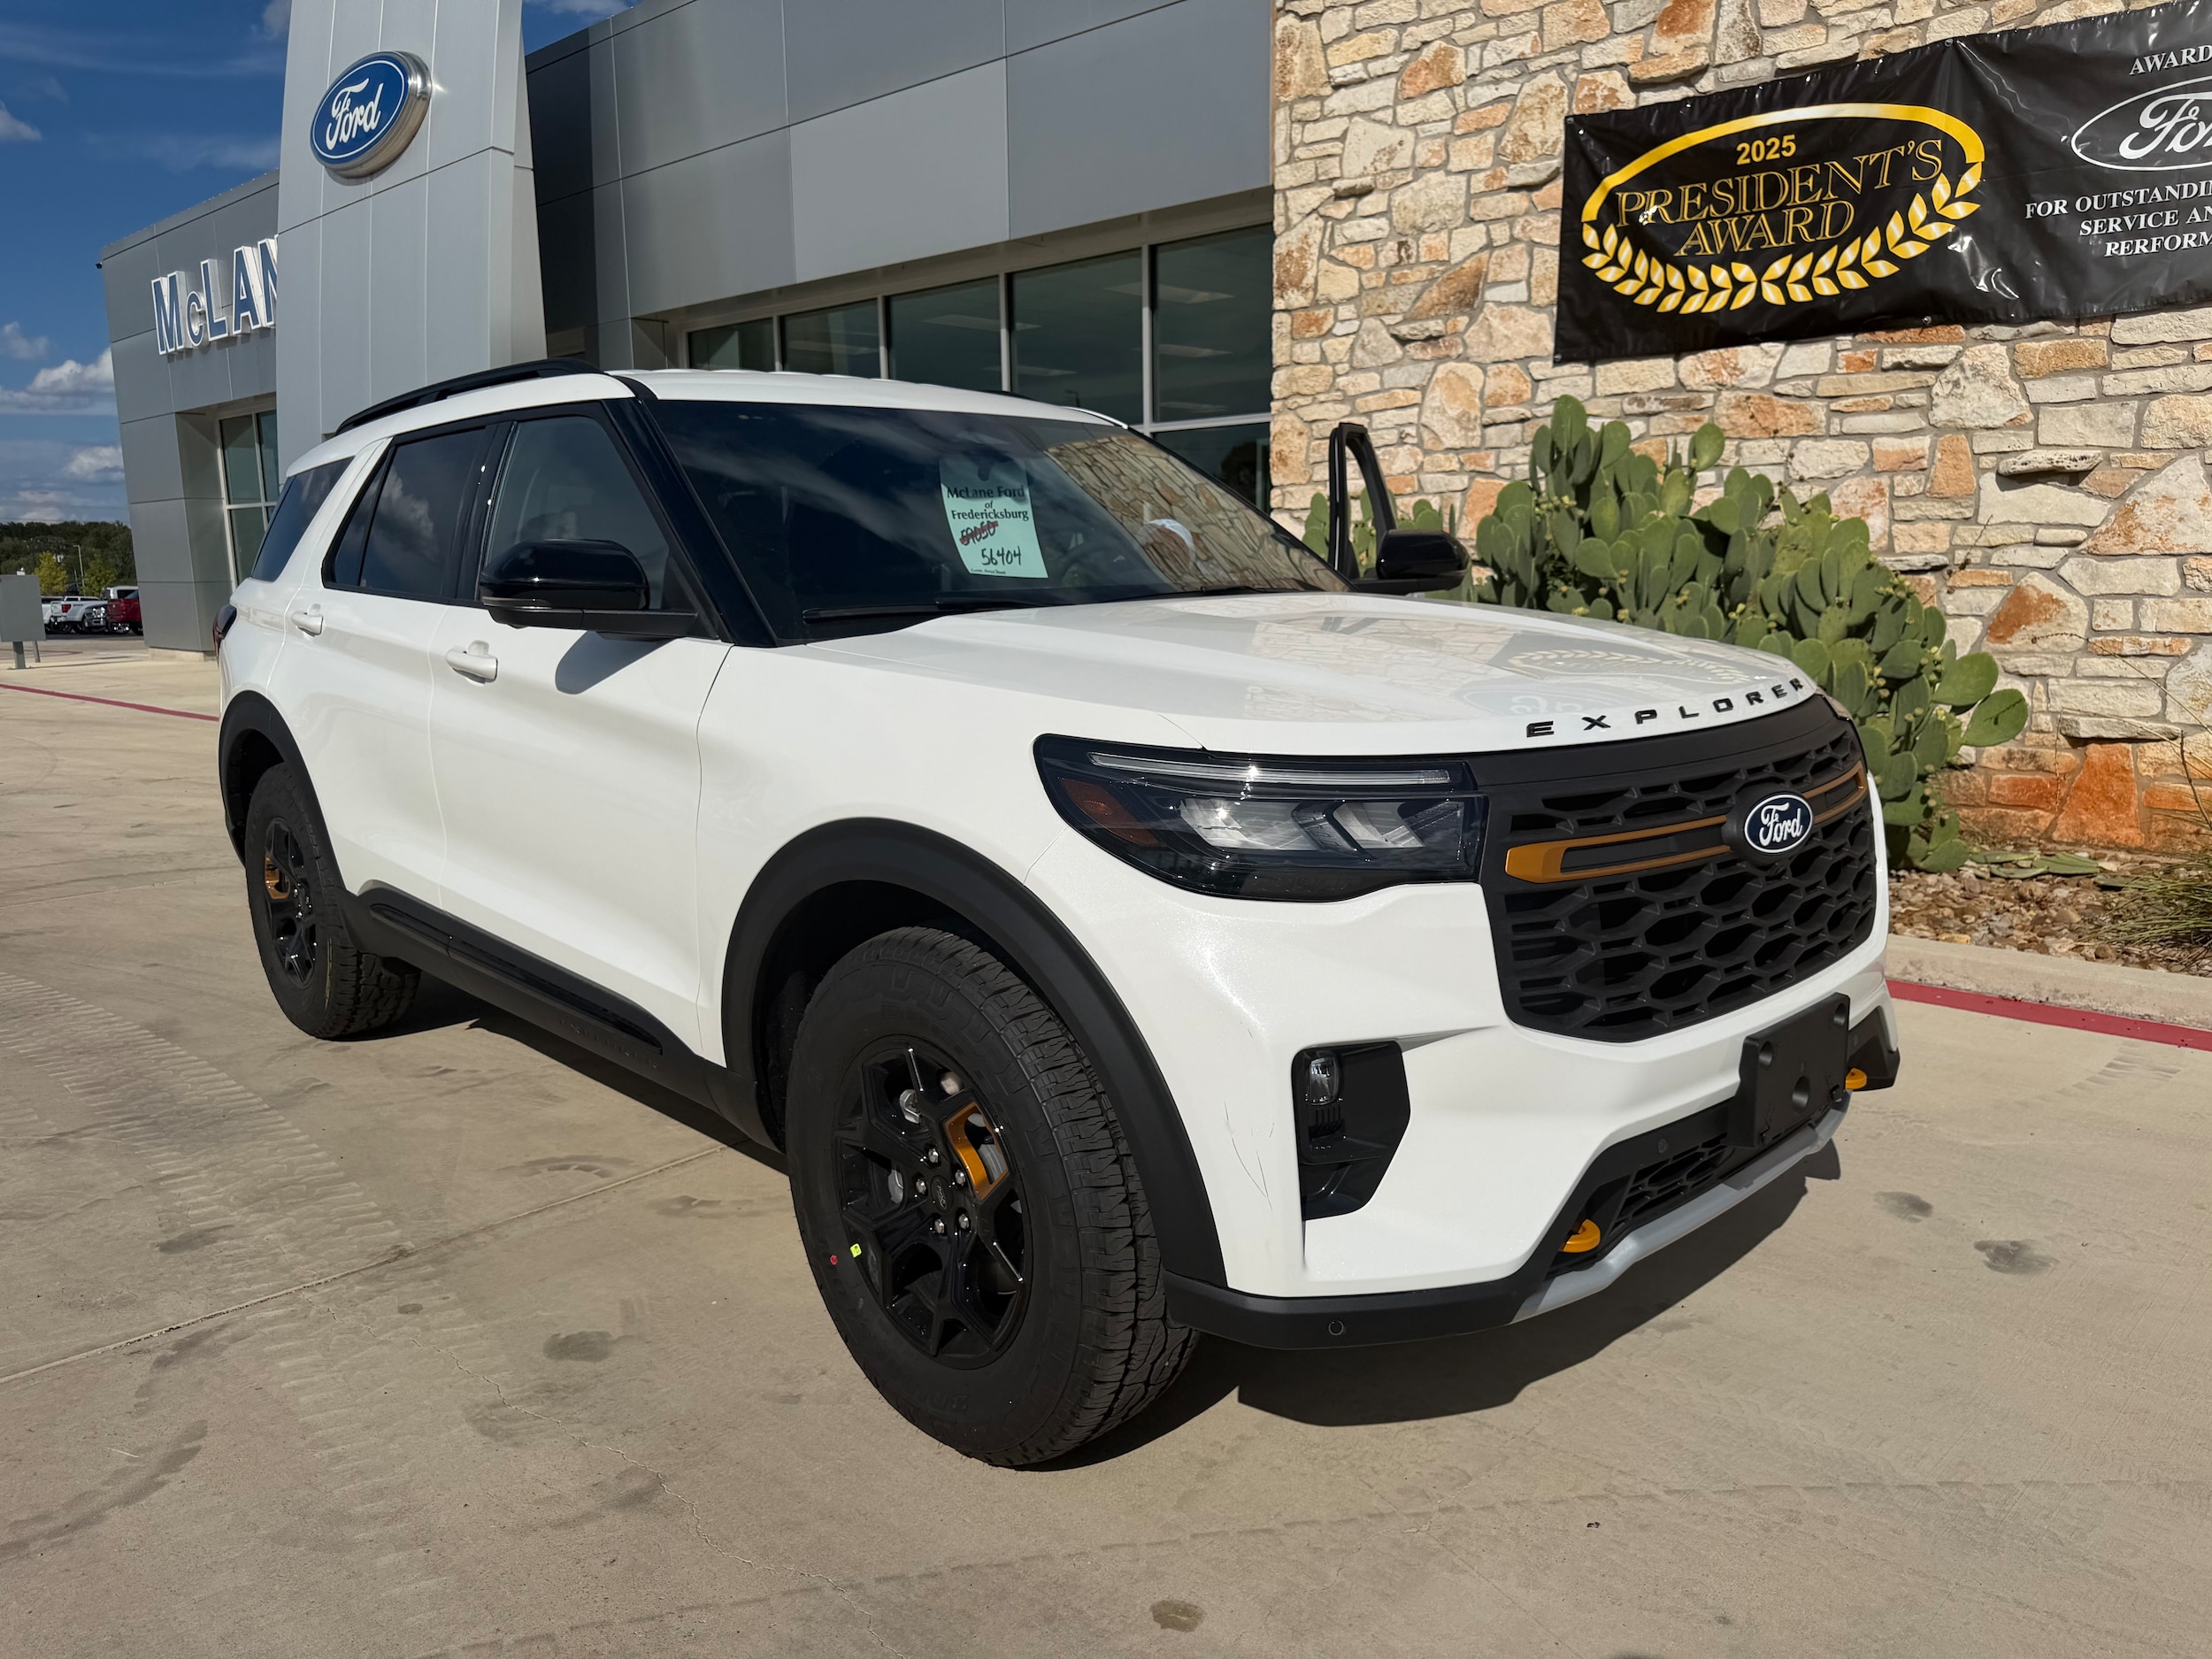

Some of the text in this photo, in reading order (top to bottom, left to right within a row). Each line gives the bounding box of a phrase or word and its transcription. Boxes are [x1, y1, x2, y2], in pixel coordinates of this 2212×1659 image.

[326, 77, 384, 150] Ford
[2119, 91, 2212, 159] Fo
[1736, 134, 1797, 165] 2025
[1615, 138, 1943, 227] PRESIDENT'S
[2024, 179, 2212, 219] FOR OUTSTANDI
[1674, 202, 1855, 257] AWARD
[2079, 210, 2178, 236] SERVICE
[947, 485, 1025, 499] McLane Ford
[951, 509, 1029, 521] Fredericksburg
[981, 546, 1022, 566] 56404
[1526, 678, 1804, 738] EXPLORER
[1758, 802, 1803, 847] Ford
